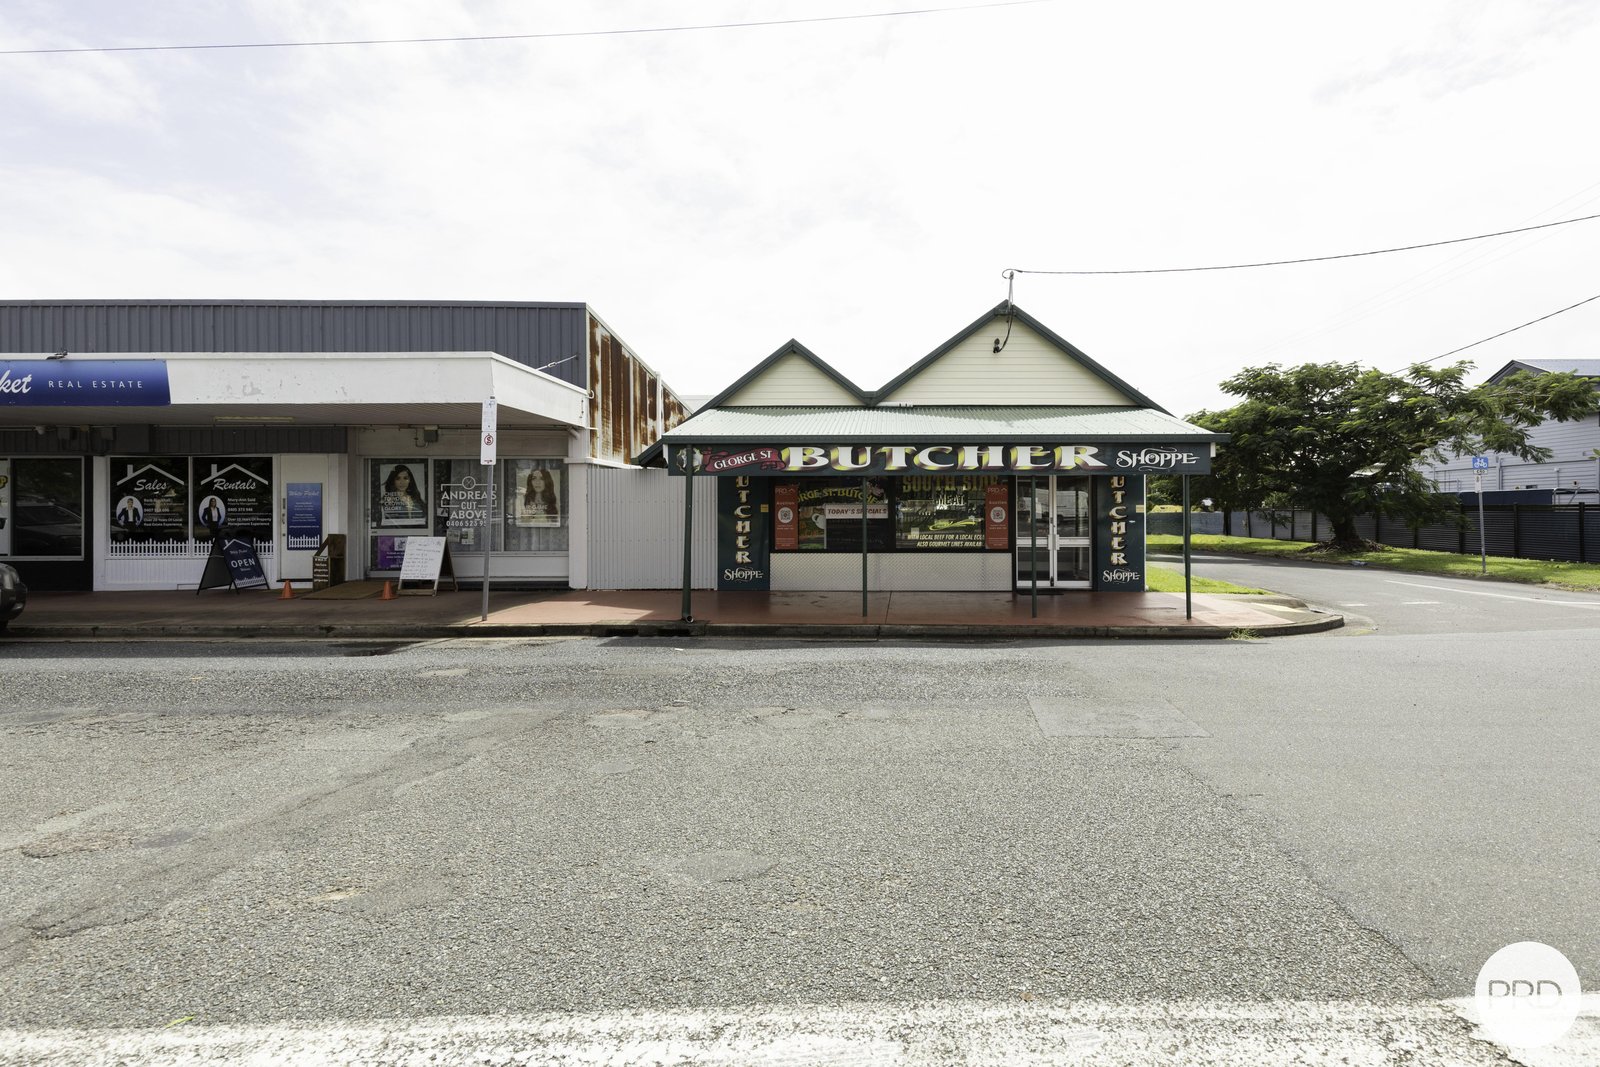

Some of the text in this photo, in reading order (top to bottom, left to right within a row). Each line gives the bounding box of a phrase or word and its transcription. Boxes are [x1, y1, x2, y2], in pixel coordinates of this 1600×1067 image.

[48, 380, 143, 389] REAL ESTATE
[713, 450, 773, 469] GEORGE ST
[783, 446, 1109, 470] BUTCHER
[1116, 447, 1200, 471] SHOPPE
[134, 478, 168, 491] Sales
[212, 478, 256, 491] Rentals
[902, 475, 958, 493] SOUTH
[461, 501, 477, 510] CUT
[450, 510, 487, 519] ABOVE
[231, 558, 255, 568] OPEN
[723, 567, 764, 582] SHOPPE
[1102, 568, 1141, 583] SHOPPE
